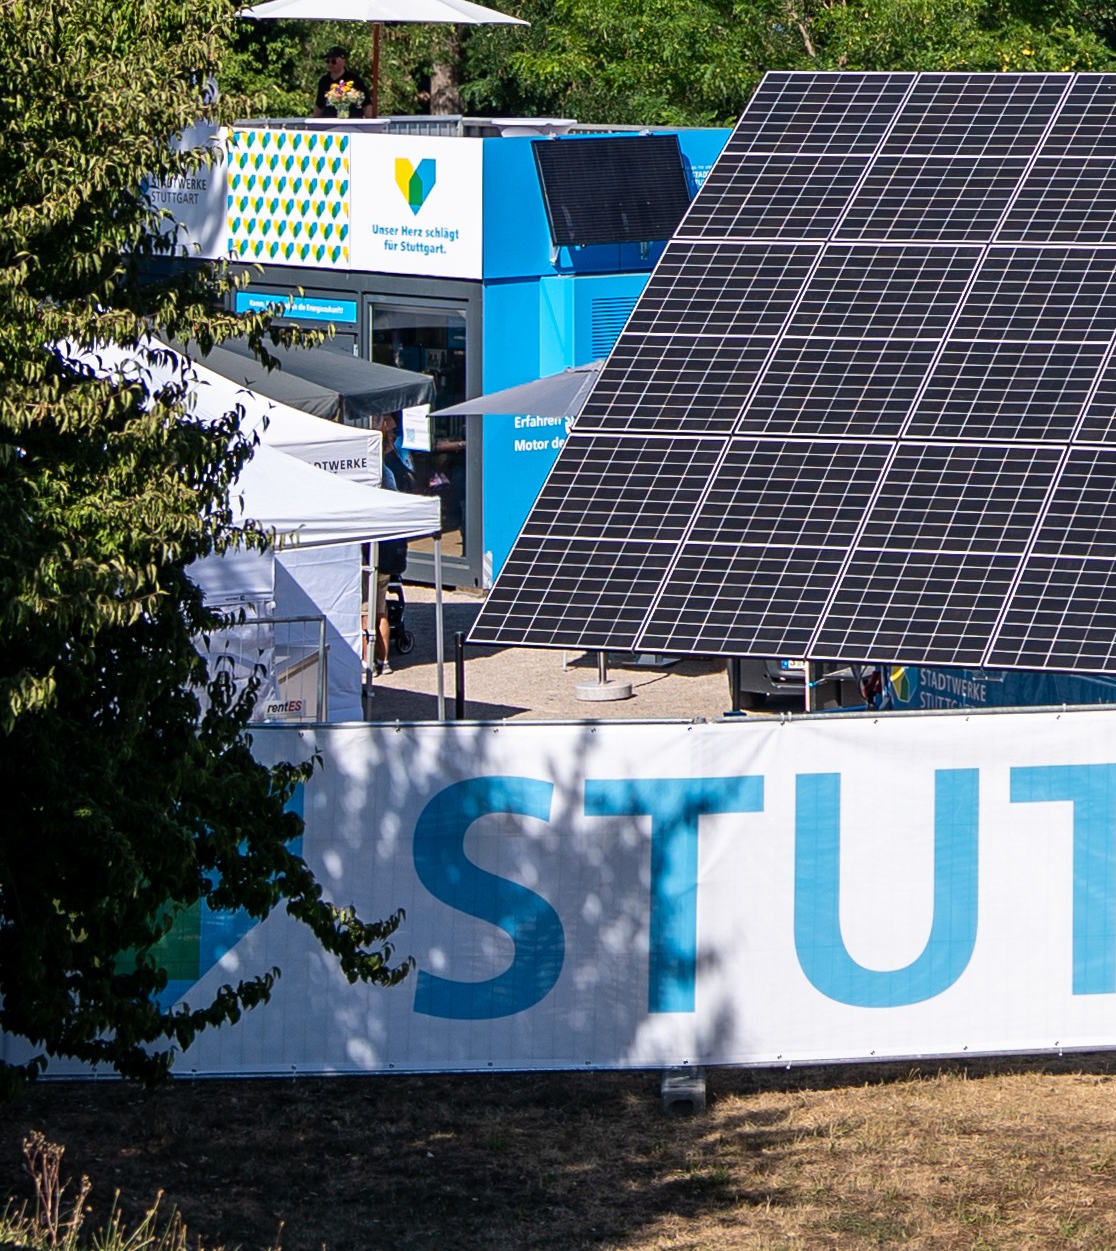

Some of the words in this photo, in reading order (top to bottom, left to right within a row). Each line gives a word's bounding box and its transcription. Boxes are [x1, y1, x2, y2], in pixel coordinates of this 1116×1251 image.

[151, 191, 199, 204] STUTTGART
[372, 224, 399, 236] Unser
[401, 225, 423, 237] Herz
[425, 227, 459, 242] schlägt
[384, 239, 398, 251] für
[400, 241, 447, 256] Stuttgart.
[514, 415, 562, 429] Erfahren
[514, 439, 550, 452] Motor
[551, 436, 566, 449] de
[308, 457, 368, 471] DTWERKE
[920, 669, 987, 703] STADTWERKE
[267, 700, 303, 713] rentES
[920, 692, 977, 709] STUTTG
